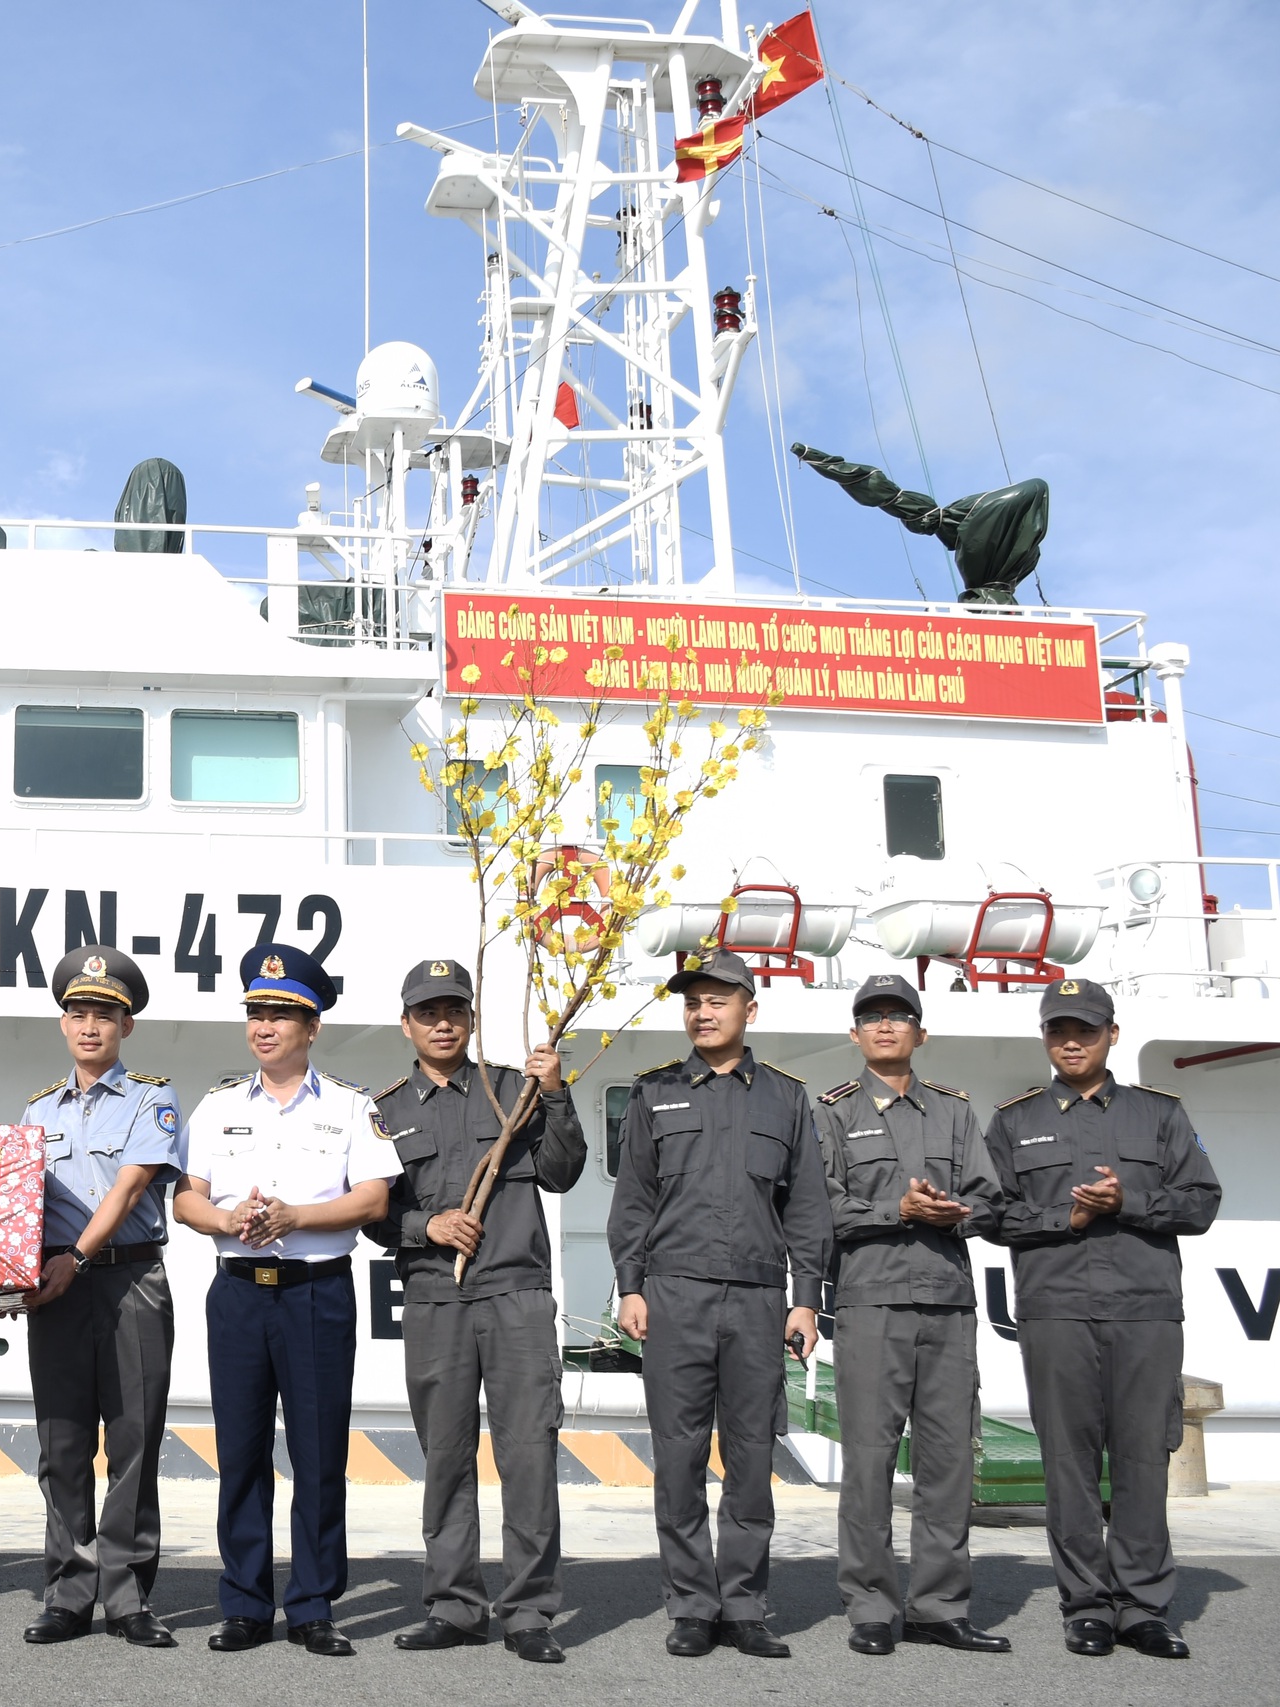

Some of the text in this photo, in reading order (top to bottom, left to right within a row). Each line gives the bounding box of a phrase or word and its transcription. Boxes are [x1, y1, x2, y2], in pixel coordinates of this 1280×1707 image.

[400, 383, 430, 392] ALPHA
[457, 601, 495, 639] ĐẢNG
[499, 607, 536, 646] CỘNG
[540, 604, 568, 642] SẢN
[570, 609, 598, 649] VIỆT
[602, 616, 634, 645] NAM
[646, 612, 688, 648] NGƯỜI
[690, 615, 726, 649] LÃNH
[729, 621, 759, 655] ĐẠO,
[761, 612, 779, 652] TỔ
[782, 619, 817, 654] CHỨC
[820, 626, 845, 660] MỌI
[848, 618, 891, 657] THẮNG
[894, 627, 915, 666] LỢI
[918, 622, 944, 660] CỦA
[946, 627, 982, 662] CÁCH
[984, 634, 1024, 669] MẠNG
[1025, 632, 1052, 672] VIỆT
[1055, 639, 1086, 668] NAM
[705, 658, 733, 692] NHÀ
[736, 660, 773, 694] NƯỚC
[776, 659, 812, 697] QUẢN
[815, 664, 835, 700] LÝ,
[837, 667, 875, 698] NHÂN
[877, 667, 905, 700] DÂN
[907, 668, 936, 702] LÀM
[939, 667, 964, 704] CHỦ
